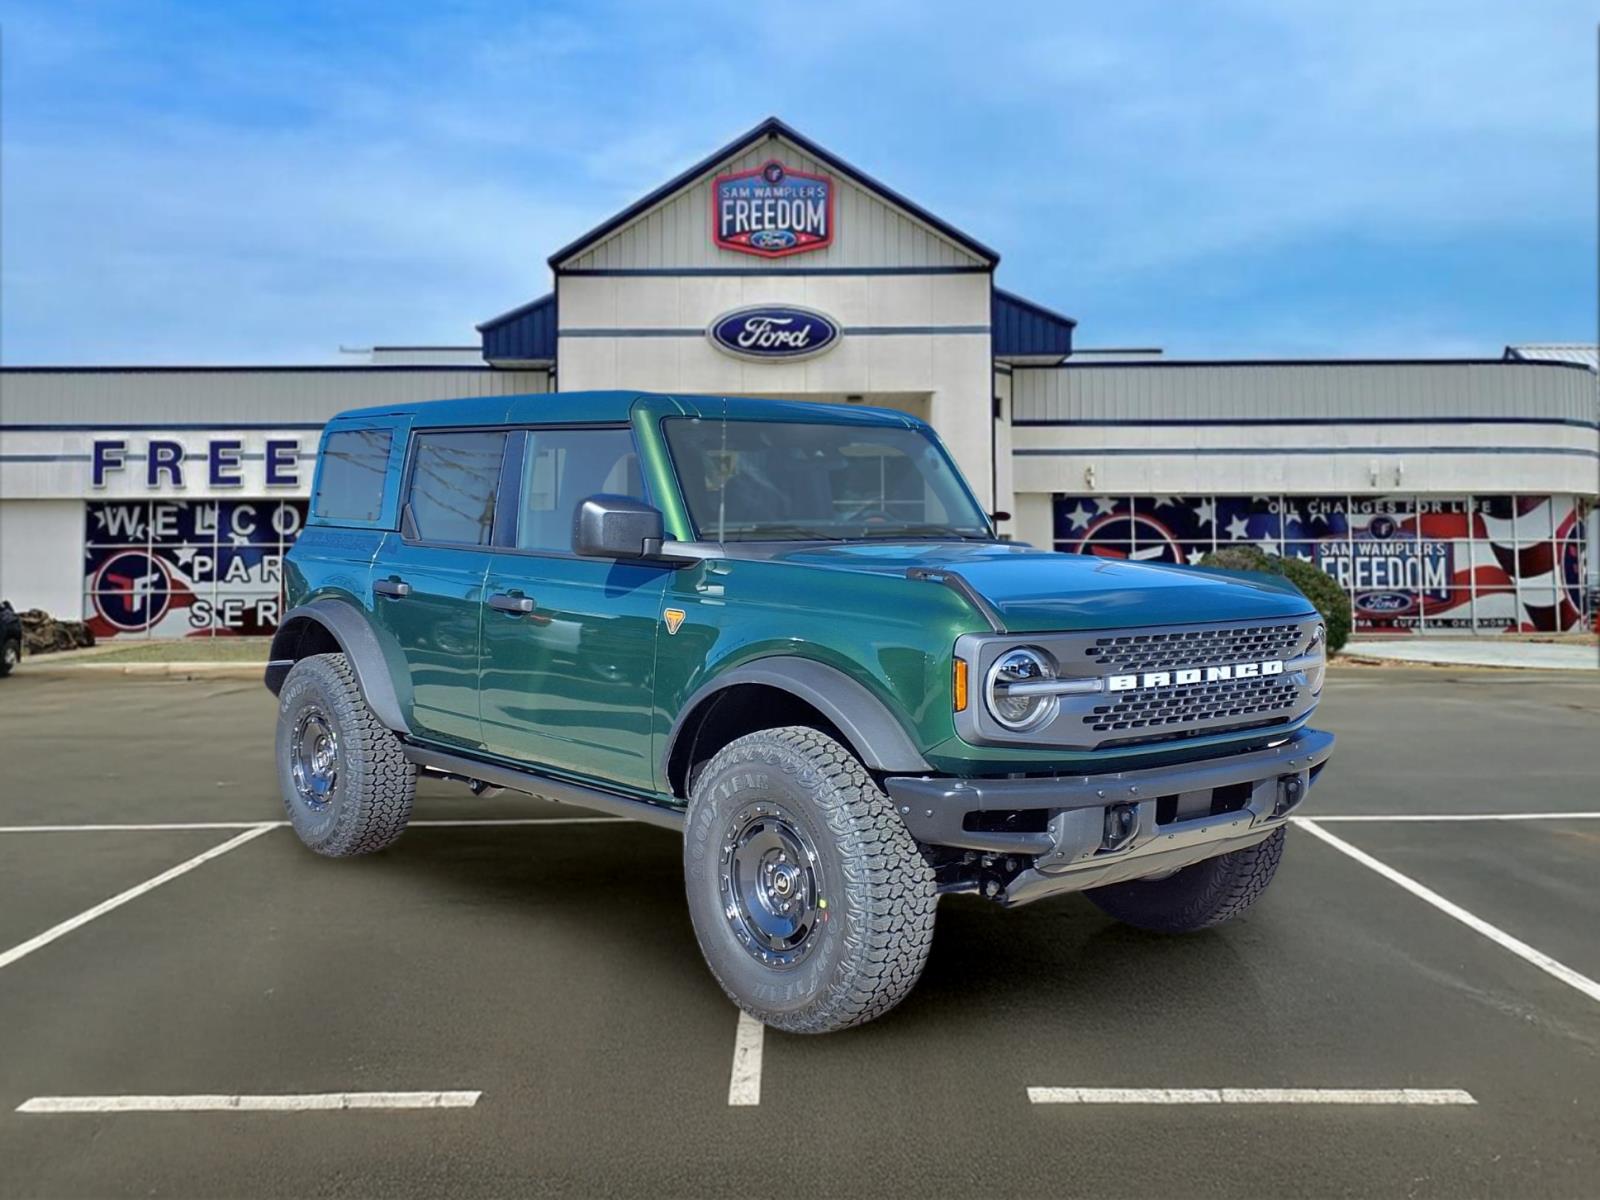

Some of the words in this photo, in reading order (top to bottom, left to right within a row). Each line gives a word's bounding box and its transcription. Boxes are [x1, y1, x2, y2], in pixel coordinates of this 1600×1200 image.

[722, 187, 749, 198] SAM
[722, 200, 825, 236] FREEDOM
[759, 232, 788, 247] Ford
[738, 317, 811, 347] Ford
[92, 439, 301, 486] FREE
[106, 506, 299, 536] WELCO
[1268, 501, 1299, 514] OIL
[1308, 501, 1397, 514] CHANGES
[1406, 500, 1442, 513] FOR
[1451, 500, 1492, 513] LIFE
[192, 556, 281, 582] PAR
[1321, 557, 1447, 598] FREEDOM
[190, 601, 278, 627] SER
[1366, 596, 1401, 608] Ford
[1109, 660, 1284, 691] BRONCO
